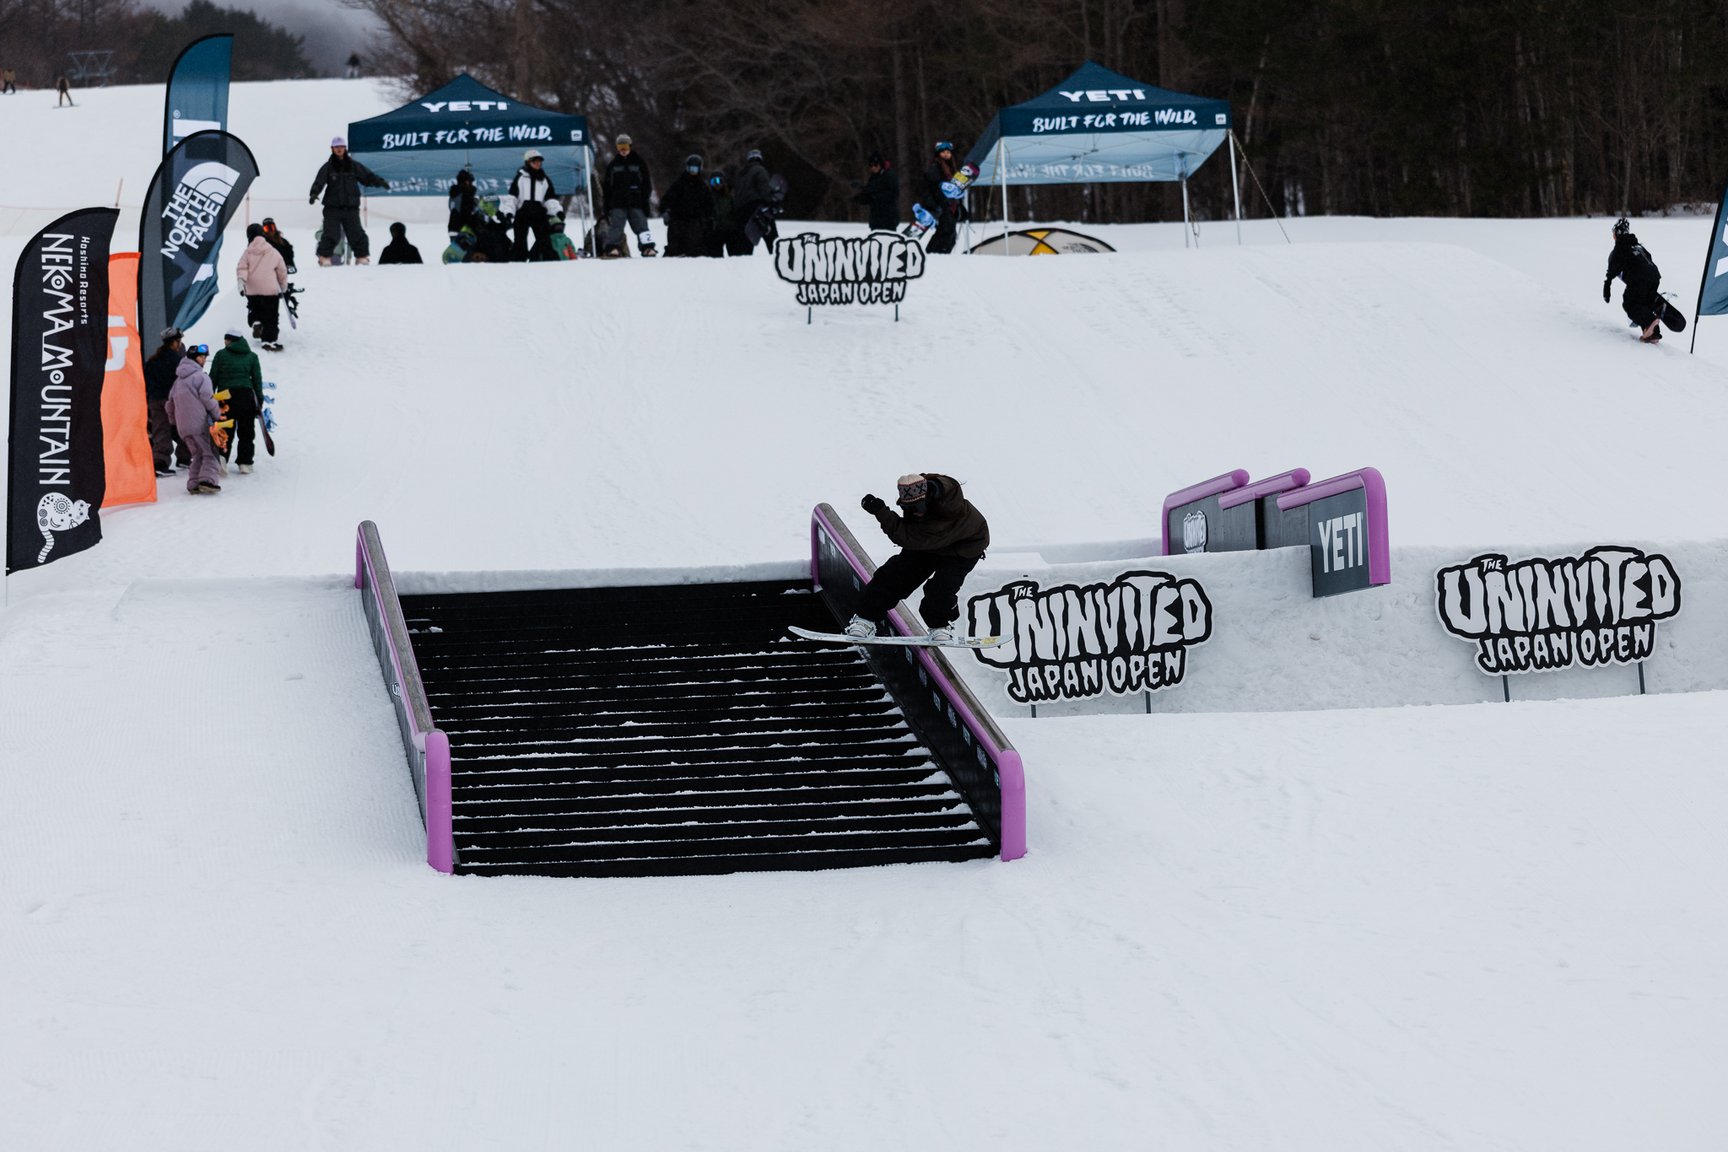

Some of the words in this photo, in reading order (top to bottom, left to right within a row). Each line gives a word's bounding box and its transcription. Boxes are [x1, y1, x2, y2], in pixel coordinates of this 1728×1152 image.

[421, 101, 508, 113] YETI
[1059, 89, 1146, 103] YETI
[382, 132, 431, 150] BUILT
[435, 129, 470, 144] FOR
[472, 127, 504, 142] THE
[508, 124, 553, 142] WILD.
[1032, 115, 1080, 133] BUILT
[1083, 113, 1116, 129] FOR
[1119, 111, 1151, 126] THE
[1154, 108, 1198, 126] WILD.
[161, 183, 193, 220] THE
[160, 193, 207, 259] NORTH
[184, 200, 221, 249] FACE
[80, 236, 90, 278] Hoshino
[778, 235, 923, 282] UNINVITED
[41, 233, 74, 337] NEKOMA
[80, 281, 89, 325] Resorts
[798, 283, 853, 303] JAPAN
[859, 282, 905, 303] OPEN
[39, 343, 74, 484] MOUNTAIN
[1318, 512, 1364, 574] YETI
[1480, 558, 1502, 573] THE
[1011, 585, 1034, 600] THE
[1443, 551, 1675, 633] UNINVITED
[974, 576, 1206, 663] UNINVITED
[1482, 631, 1568, 668] JAPAN
[1580, 623, 1651, 661] OPEN
[1012, 658, 1100, 698] JAPAN
[1111, 650, 1182, 689] OPEN
